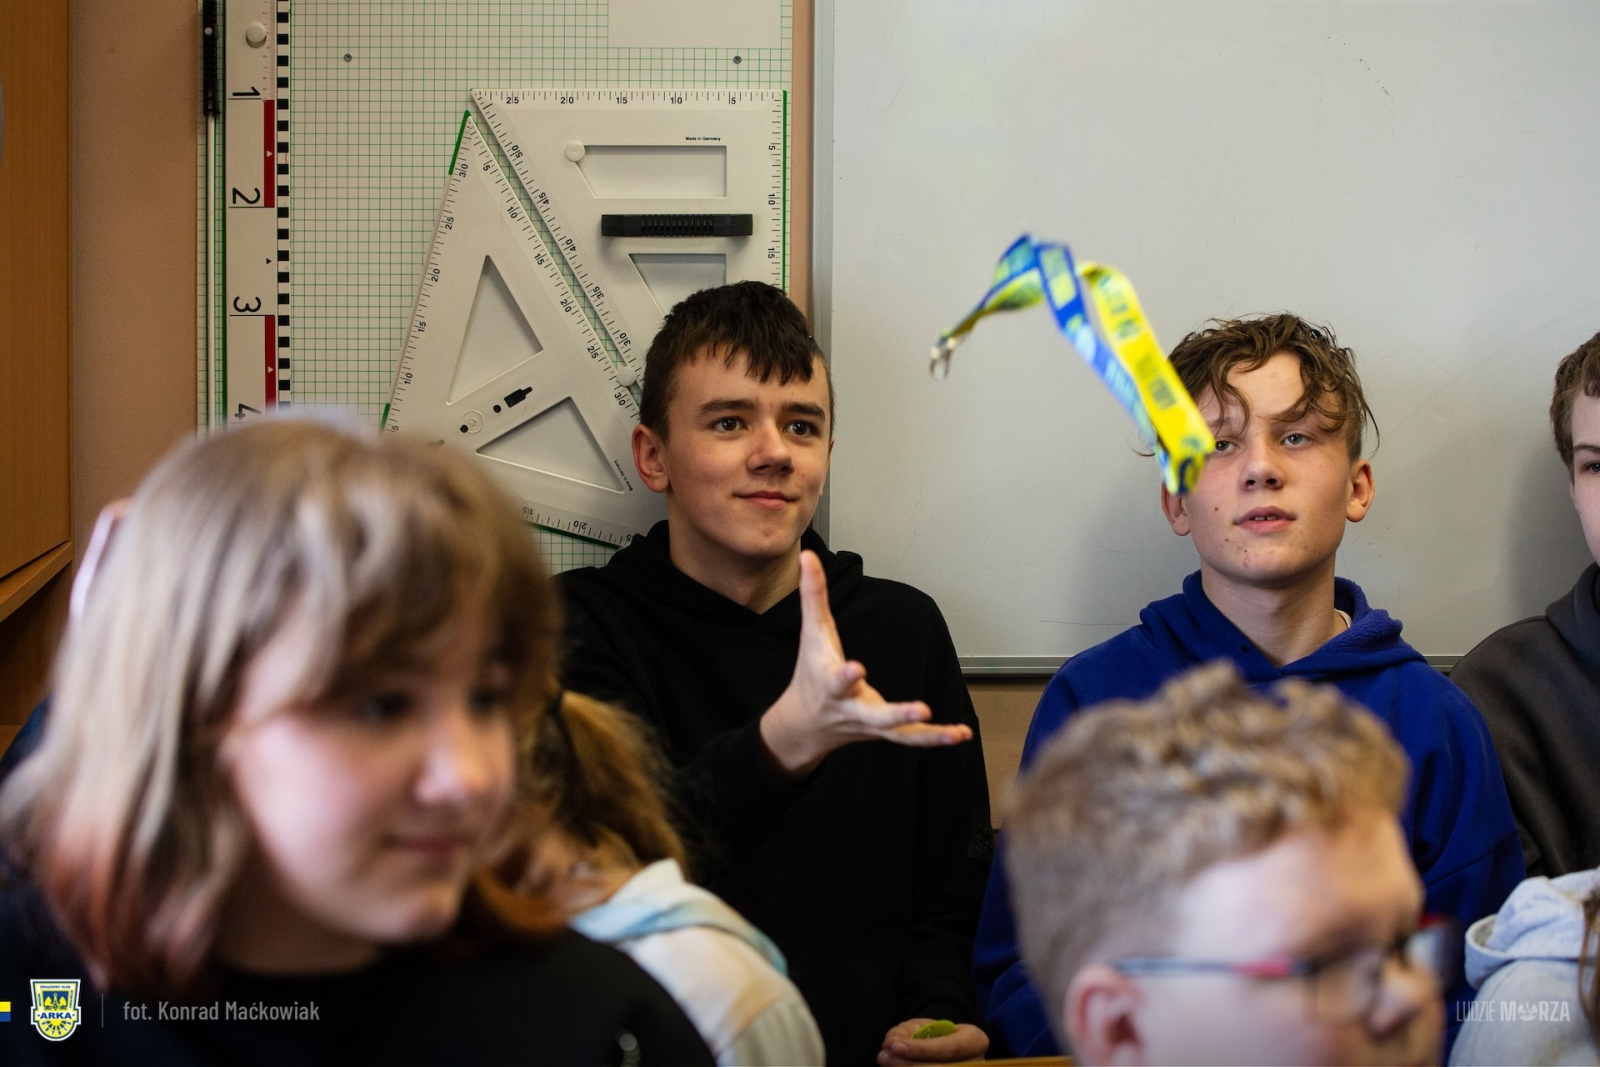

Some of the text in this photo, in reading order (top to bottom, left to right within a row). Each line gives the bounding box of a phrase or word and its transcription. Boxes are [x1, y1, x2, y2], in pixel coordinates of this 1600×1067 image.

[232, 86, 261, 96] 1
[506, 96, 737, 105] 25 20 15 10 5
[231, 187, 261, 206] 2
[768, 193, 776, 206] 10
[512, 144, 631, 346] 30 35 40 45 50
[768, 248, 776, 259] 15
[404, 372, 414, 386] 10
[418, 320, 427, 334] 15
[430, 268, 441, 283] 20
[444, 216, 455, 230] 25
[458, 162, 469, 178] 30
[483, 162, 626, 406] 5 10 15 20 25 30
[232, 296, 262, 313] 3
[574, 520, 588, 530] 20
